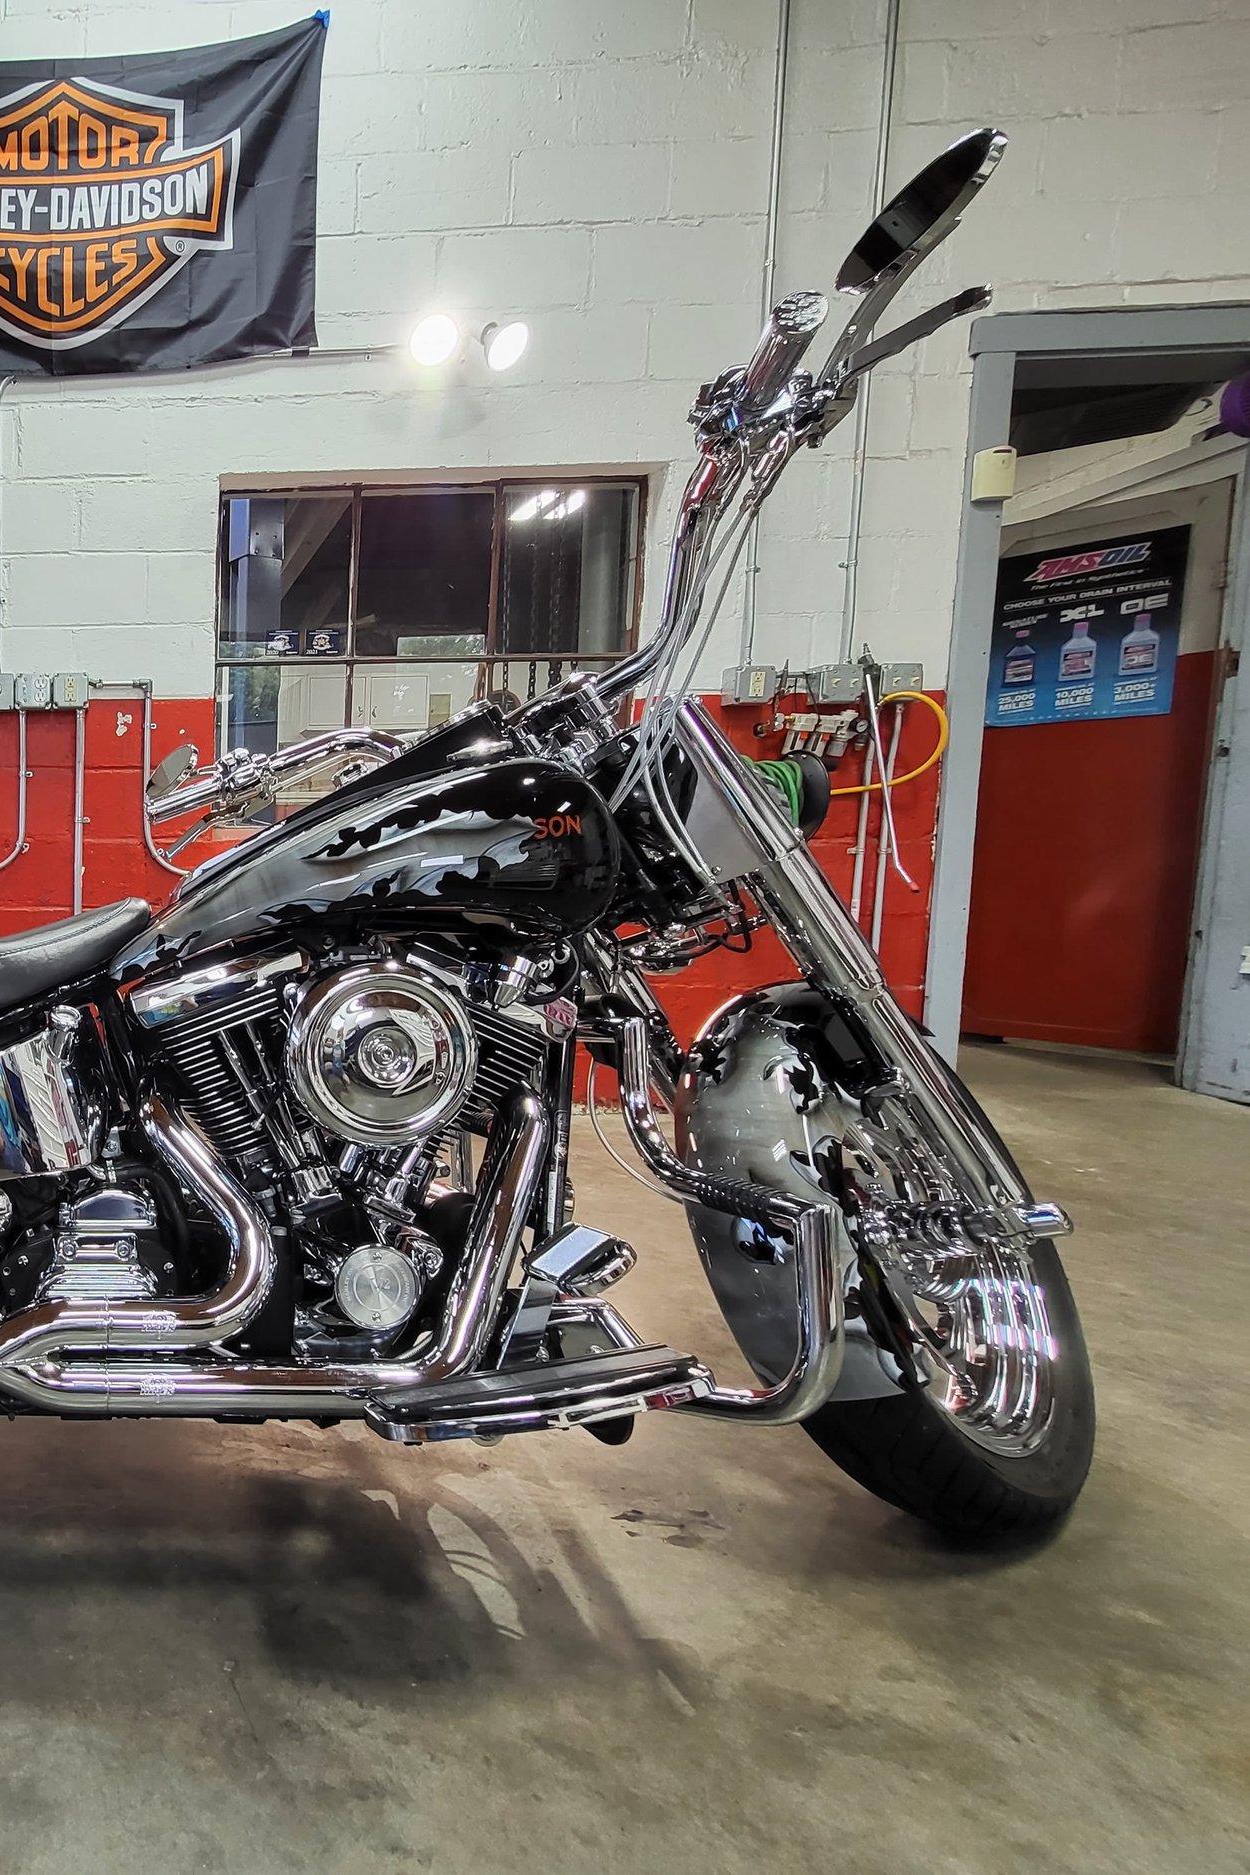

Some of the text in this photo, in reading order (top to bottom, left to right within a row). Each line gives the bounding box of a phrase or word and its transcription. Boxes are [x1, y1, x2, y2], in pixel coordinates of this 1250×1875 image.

[1023, 542, 1152, 583] AMSOIL
[1003, 580, 1172, 611] CHOOSE YOUR DRAIN INTERVAL
[1119, 593, 1169, 615] OE
[998, 692, 1036, 704] 25,000
[1056, 687, 1094, 699] 10,000
[1113, 689, 1155, 702] MILES
[998, 700, 1034, 711] MILES
[1055, 695, 1093, 707] MILES
